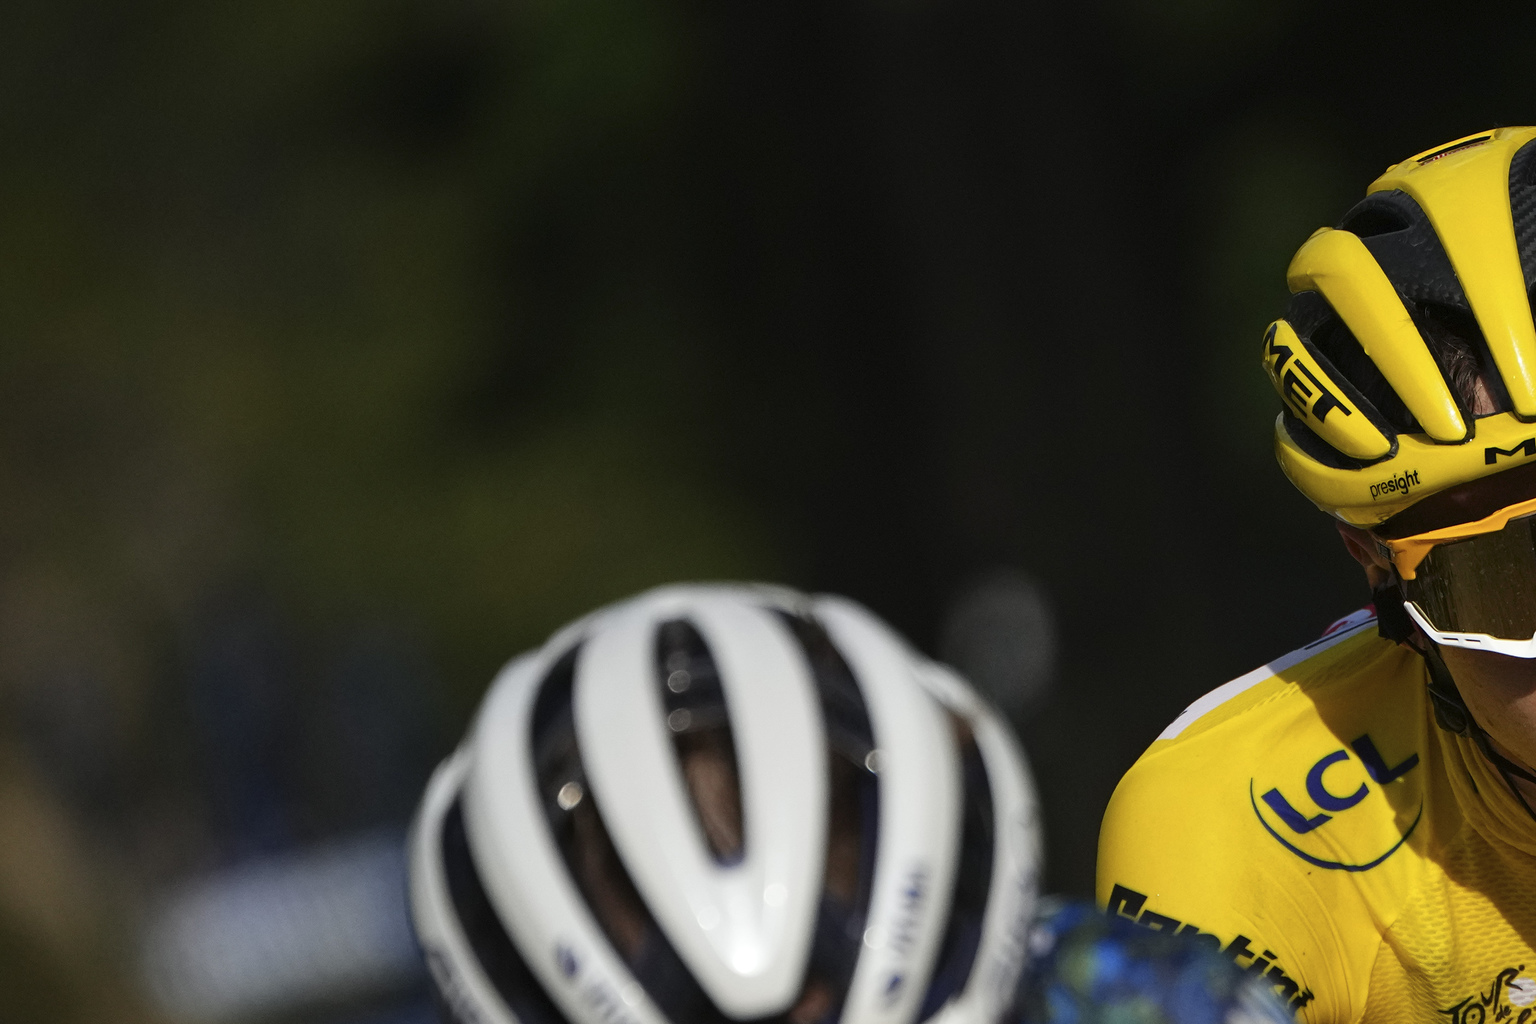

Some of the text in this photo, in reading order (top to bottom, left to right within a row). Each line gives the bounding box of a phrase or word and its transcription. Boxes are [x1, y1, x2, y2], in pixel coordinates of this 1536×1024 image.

[1263, 323, 1352, 424] MET
[1369, 469, 1421, 500] presight
[1261, 734, 1420, 834] LCL
